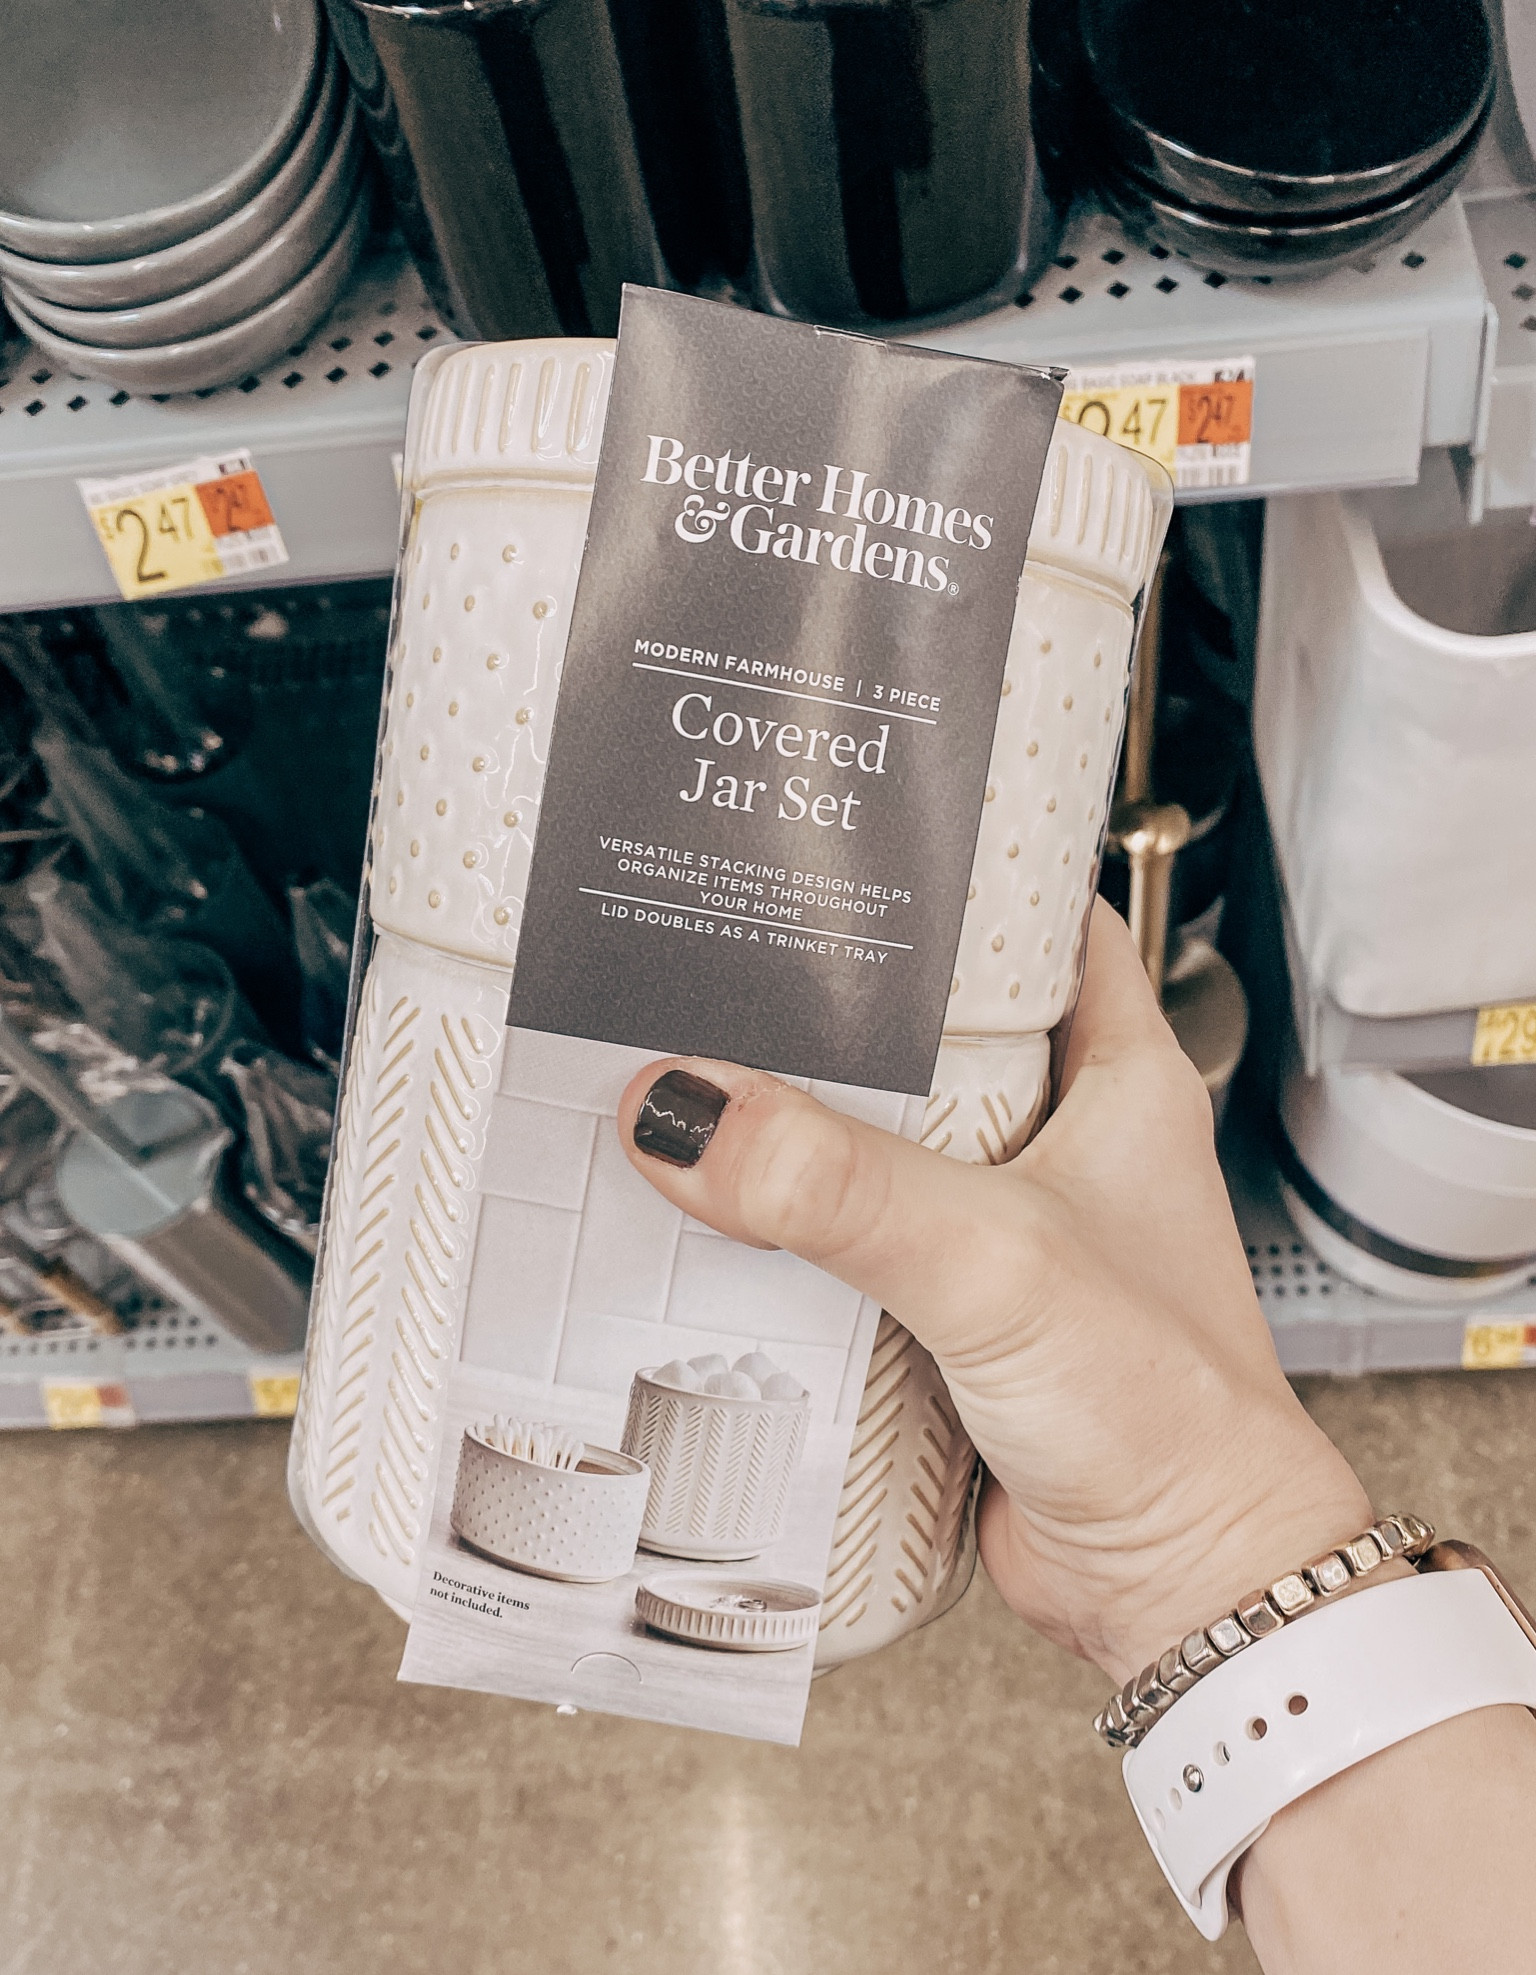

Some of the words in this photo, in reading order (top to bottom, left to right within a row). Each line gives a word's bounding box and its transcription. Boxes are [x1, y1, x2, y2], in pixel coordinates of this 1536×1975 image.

[640, 434, 812, 507] Better
[816, 464, 994, 550] Homes
[634, 638, 719, 668] MODERN
[725, 655, 845, 692] FARMHOUSE
[873, 685, 884, 700] 3
[889, 688, 941, 712] PIECE
[671, 692, 890, 774] Covered
[679, 757, 767, 813] Jar
[778, 776, 861, 831] Set
[600, 835, 694, 866] VERSATILE
[699, 854, 787, 882] STACKING
[792, 870, 855, 894] DESIGN
[860, 883, 912, 904] HELPS
[617, 858, 708, 886] ORGANIZE
[713, 876, 764, 895] ITEMS
[770, 885, 888, 918] THROUGHOUT
[601, 903, 629, 919] LID
[634, 908, 714, 935] DOUBLES
[720, 924, 743, 940] AS
[748, 929, 760, 942] A
[767, 932, 839, 956] TRINKET
[844, 945, 888, 965] TRAY
[700, 891, 748, 912] YOUR
[753, 901, 803, 921] HOME
[430, 1588, 448, 1600] not
[450, 1592, 503, 1618] included.
[433, 1571, 495, 1600] Decorative
[497, 1592, 530, 1610] items
